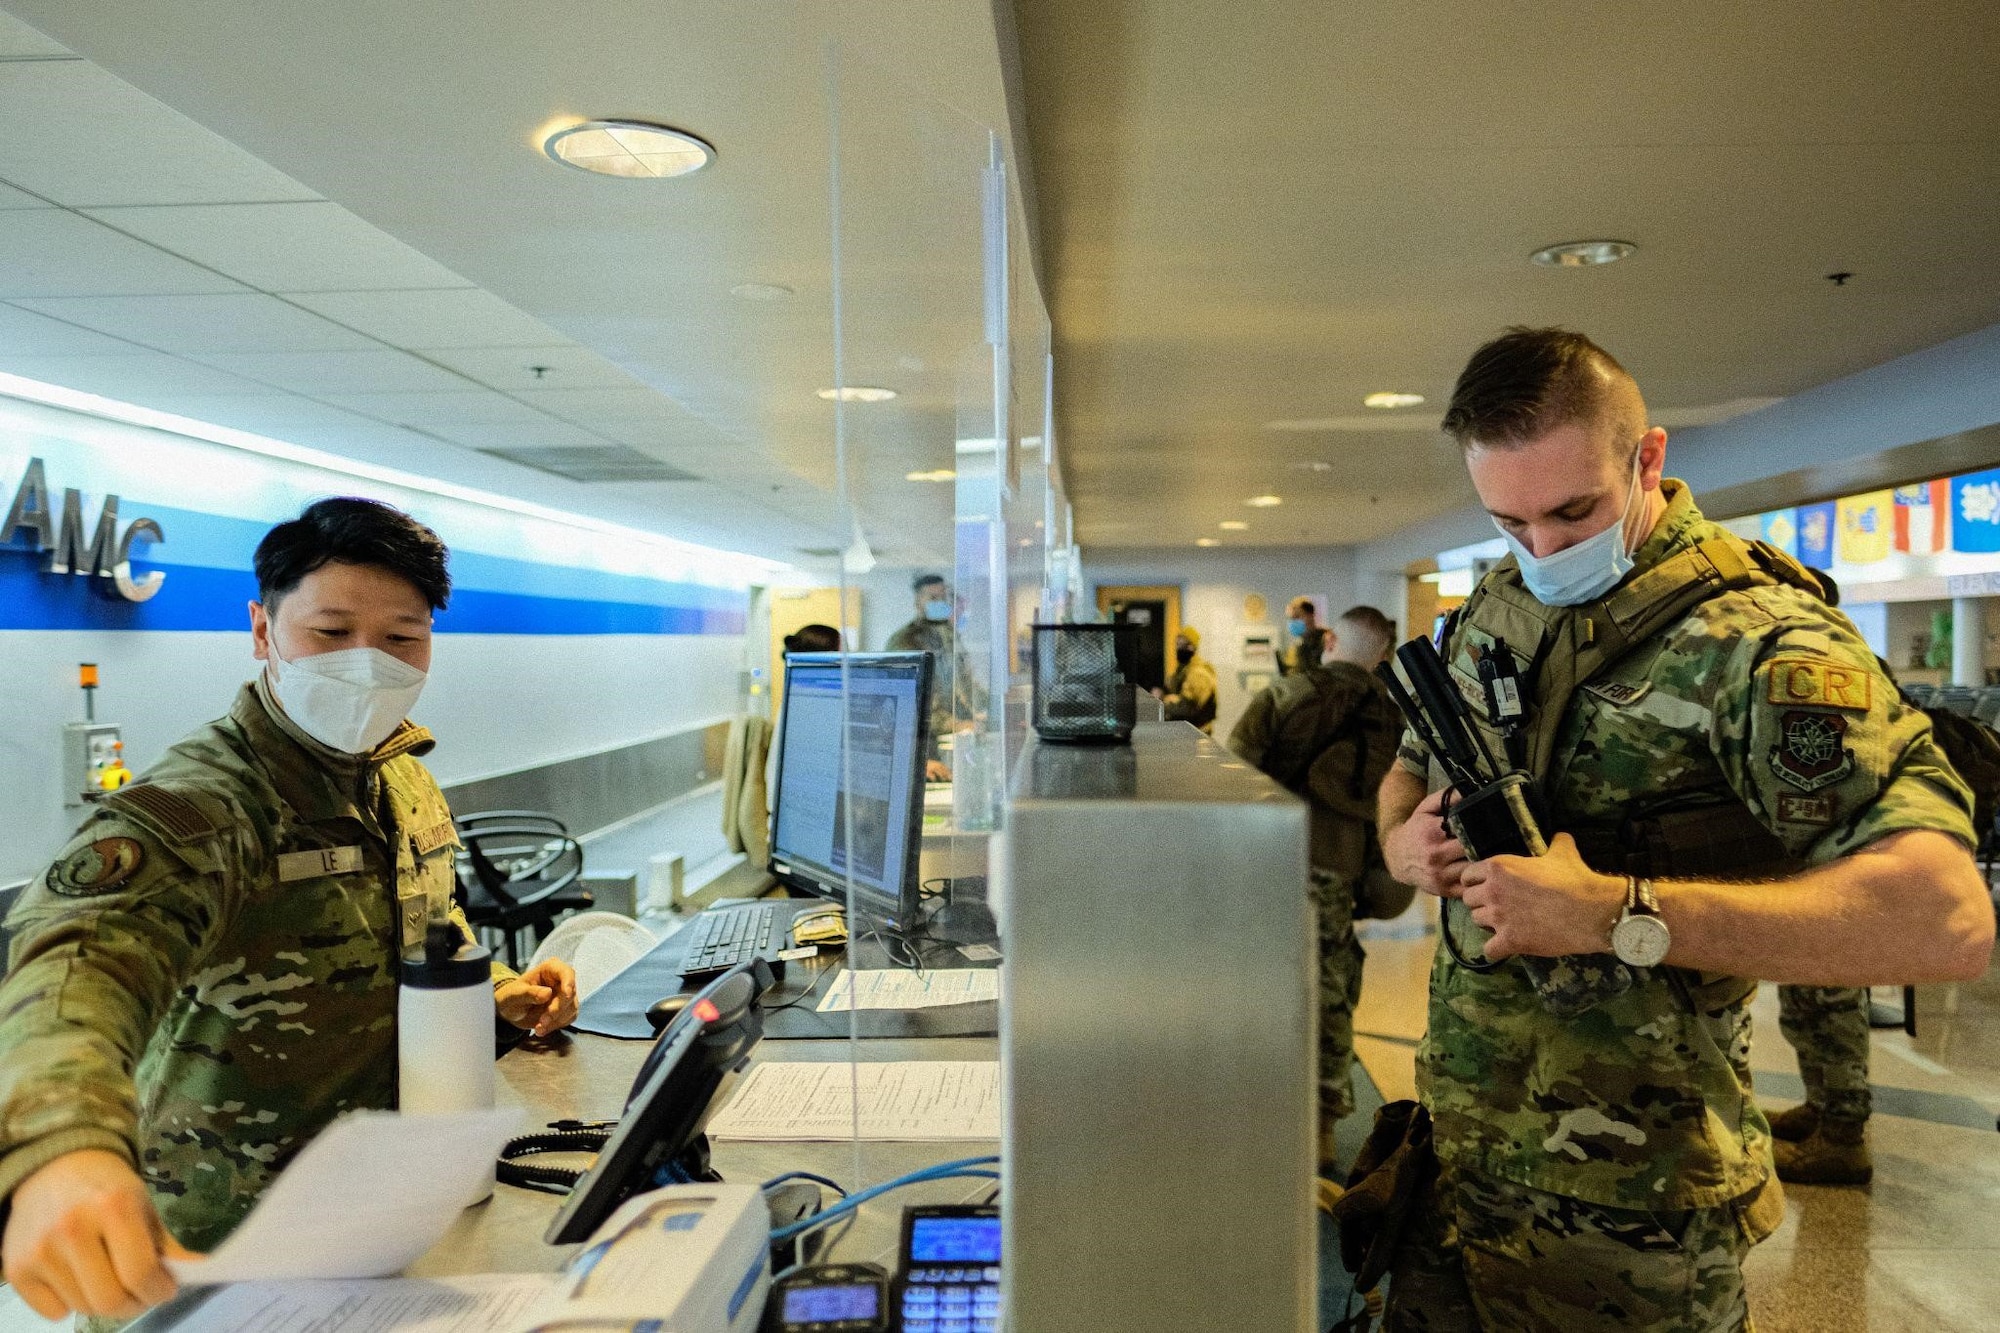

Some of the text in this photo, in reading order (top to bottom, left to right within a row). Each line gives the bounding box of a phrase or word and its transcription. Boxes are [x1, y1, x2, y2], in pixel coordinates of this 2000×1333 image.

[0, 457, 166, 602] AMC
[1786, 666, 1853, 704] CR
[321, 851, 337, 872] LE
